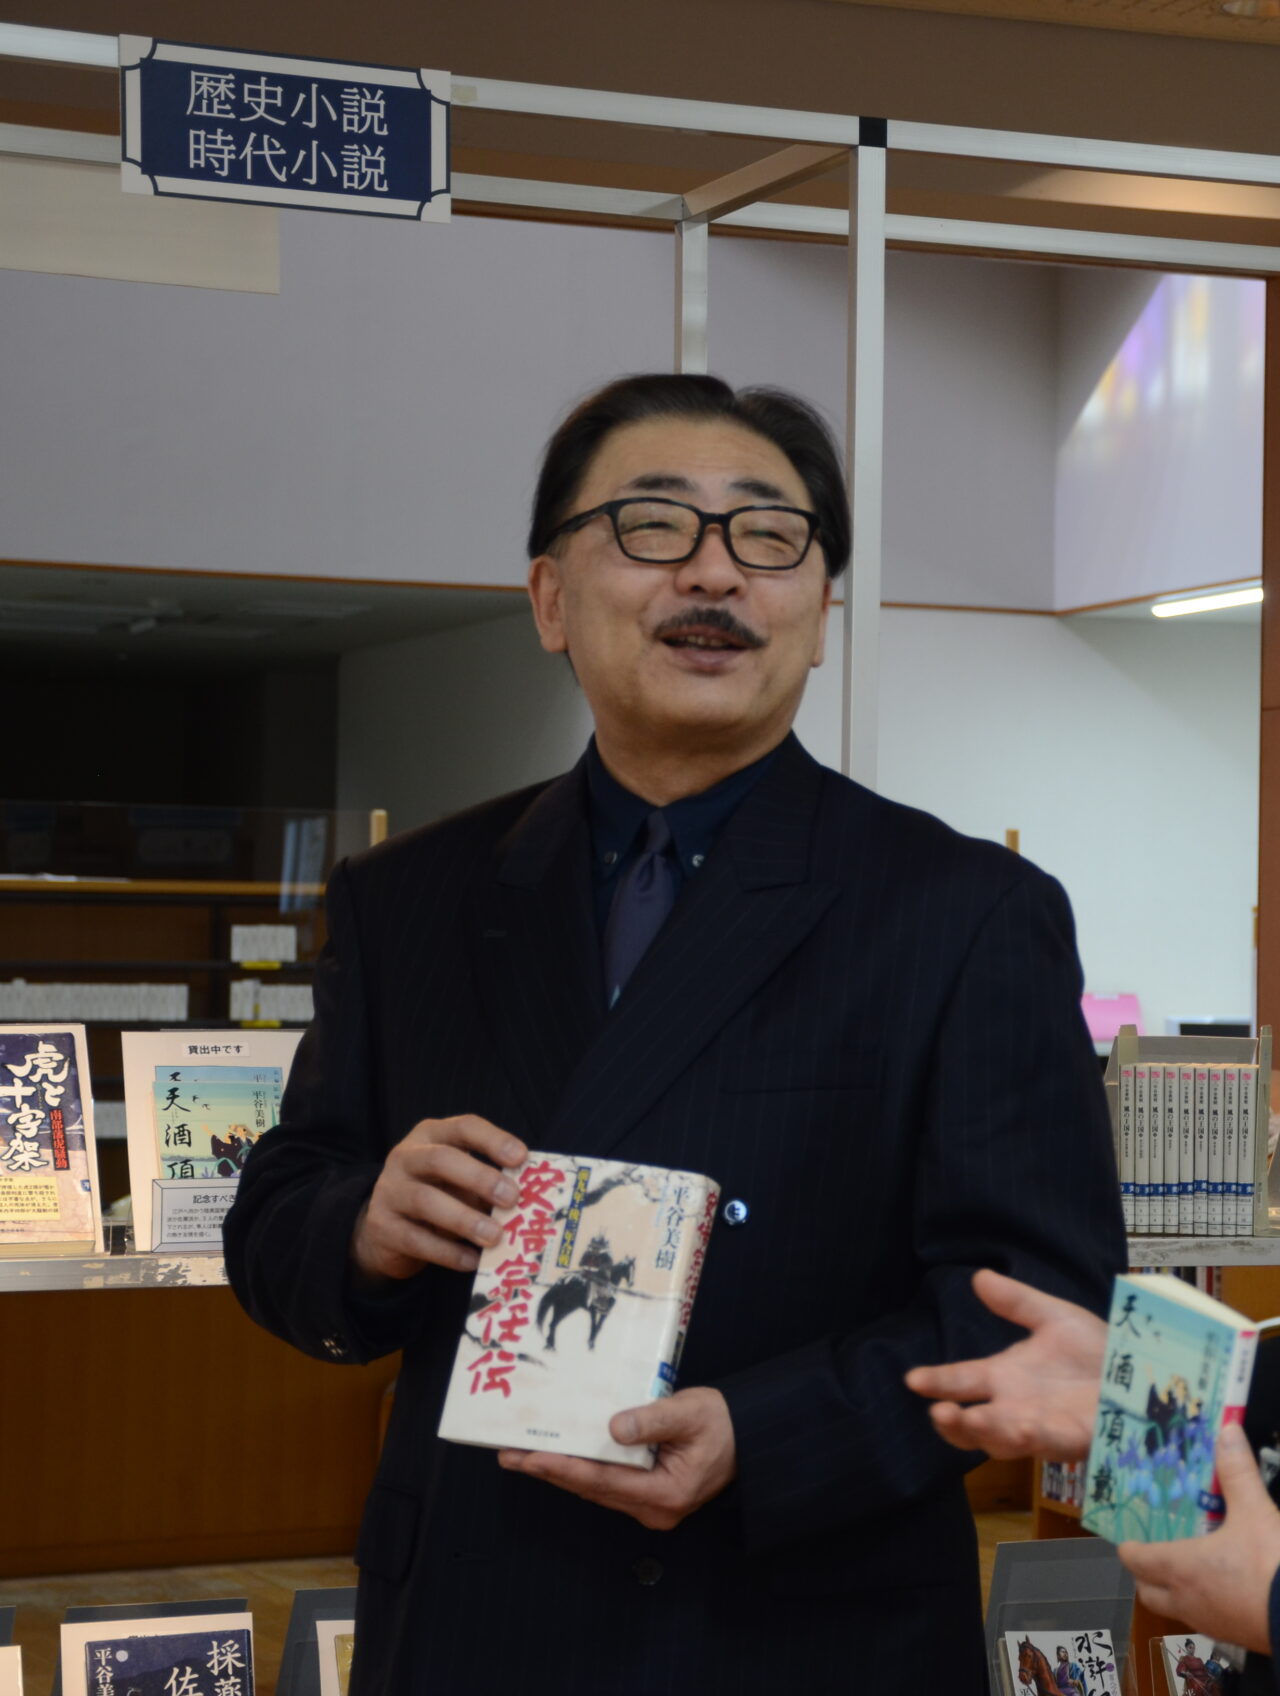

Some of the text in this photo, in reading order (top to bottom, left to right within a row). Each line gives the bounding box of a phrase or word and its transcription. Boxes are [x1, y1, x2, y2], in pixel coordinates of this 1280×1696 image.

[186, 70, 388, 136] 歴史小説
[189, 128, 389, 192] 時代小説
[5, 1041, 70, 1107] 虎と
[188, 1045, 243, 1055] 貸出中です
[0, 1077, 48, 1171] 十字架
[467, 1161, 565, 1398] 安倍宗任伝
